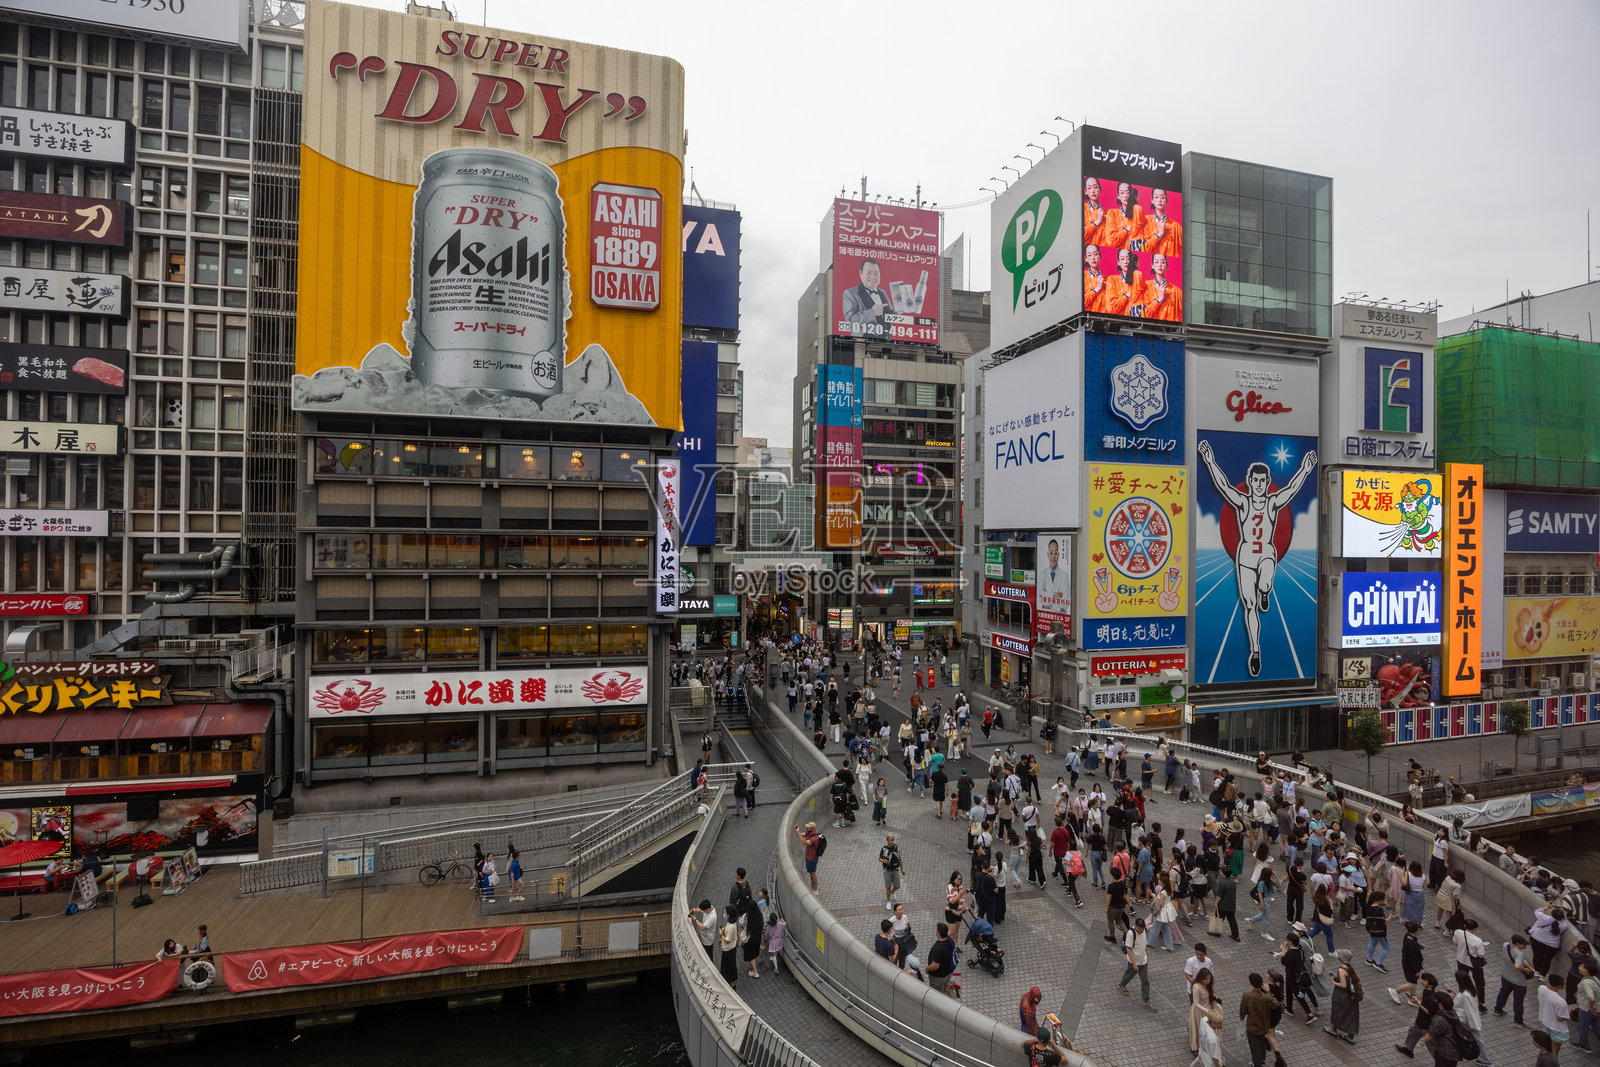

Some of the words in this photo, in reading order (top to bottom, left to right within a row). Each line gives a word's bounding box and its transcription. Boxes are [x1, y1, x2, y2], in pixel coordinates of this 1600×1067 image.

[435, 29, 569, 74] SUPER
[29, 118, 112, 139] しゃぶしゃぶ
[29, 133, 93, 153] すき焼き
[1091, 145, 1175, 175] ピップマグネループ
[471, 194, 516, 208] SUPER
[594, 194, 658, 228] ASAHI
[839, 202, 894, 220] スーパー
[72, 204, 113, 238] 刀
[839, 217, 937, 240] ミリオンヘアー
[611, 225, 641, 239] since
[594, 235, 657, 269] 1889
[839, 234, 872, 245] SUPER
[875, 238, 911, 250] MILLION
[913, 241, 937, 253] HAIR
[428, 229, 550, 286] Asahi
[475, 285, 506, 306] 生
[508, 288, 525, 296] UNDER
[509, 281, 534, 291] PRECISION
[594, 270, 657, 303] OSAKA
[1024, 263, 1064, 309] ピップ
[508, 295, 529, 304] MASTER
[519, 303, 549, 315] TECHNIQUES
[520, 311, 536, 319] CLEAN
[886, 315, 905, 323] ルアン
[1367, 309, 1415, 324] 夢ある住まい
[454, 321, 526, 337] スーパードライ
[852, 322, 937, 340] 0120-494-111
[1359, 325, 1423, 341] エステムシリーズ
[17, 356, 67, 368] 黒毛和牛
[472, 359, 505, 370] 生ビール
[534, 360, 557, 381] お酒
[17, 367, 68, 380] 食べ放題
[1226, 390, 1292, 422] Glico
[989, 405, 1075, 436] なにげない感動をずっと。
[11, 426, 81, 451] 木屋
[1102, 435, 1177, 451] 雪印メグミルク
[1346, 436, 1436, 460] 日商エステム
[995, 430, 1064, 470] FANCL
[1355, 476, 1390, 490] かぜに
[1351, 491, 1394, 512] 改源
[1111, 513, 1123, 532] SNOW
[1155, 513, 1167, 533] SNOW
[1528, 511, 1598, 535] SAMTY
[1250, 512, 1265, 555] グリコ
[1111, 544, 1123, 563] SNOW
[1155, 544, 1167, 563] SNOW
[1455, 475, 1477, 682] オリエントホーム
[997, 586, 1026, 599] LOTTERIA
[1348, 579, 1435, 628] CHINTAI
[1002, 640, 1030, 653] LOTTERIA
[16, 661, 156, 676] ハンバーグレストラン
[1096, 660, 1147, 671] LOTTERIA
[4, 976, 146, 1000] い大阪を見つけにいこう
